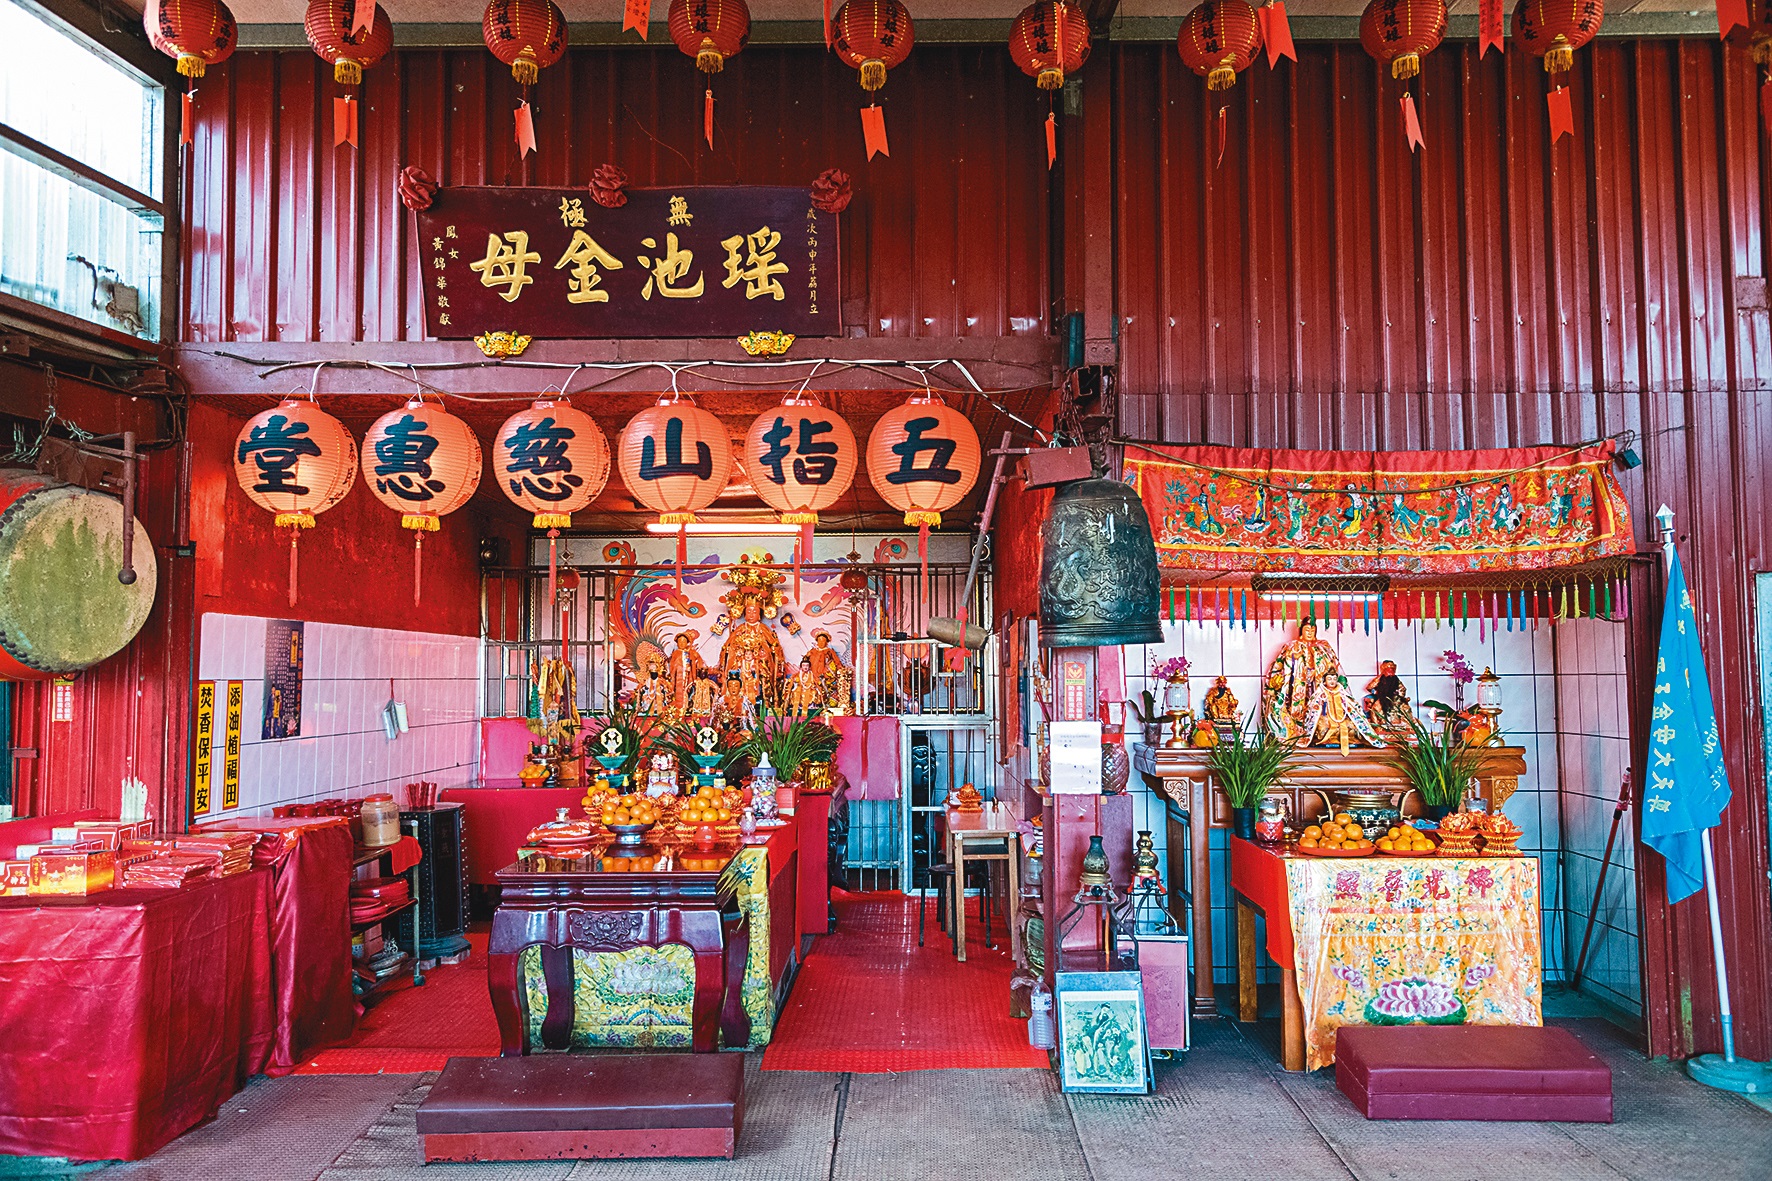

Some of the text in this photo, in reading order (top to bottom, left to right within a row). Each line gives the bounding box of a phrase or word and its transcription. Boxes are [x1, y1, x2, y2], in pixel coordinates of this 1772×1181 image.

[558, 195, 694, 228] 無極
[196, 686, 213, 811] 焚香保平安
[225, 686, 241, 805] 添油植福田
